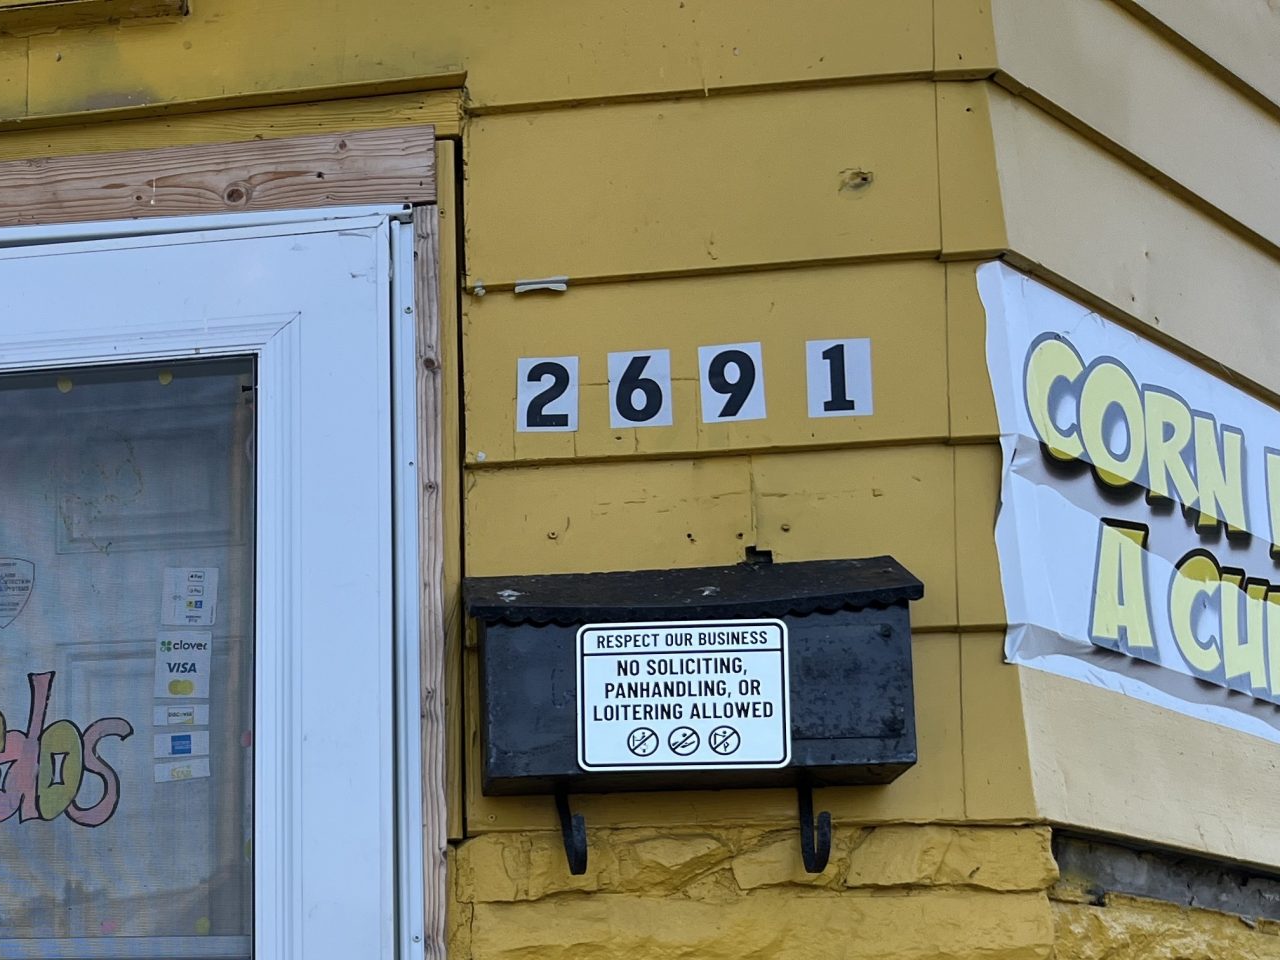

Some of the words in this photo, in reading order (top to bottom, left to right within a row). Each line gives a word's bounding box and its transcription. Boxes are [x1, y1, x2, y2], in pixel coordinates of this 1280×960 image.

[526, 343, 856, 428] 2691
[1023, 331, 1249, 538] CORN
[1089, 518, 1157, 652] A
[173, 639, 208, 650] clover
[596, 633, 660, 649] RESPECT
[665, 632, 693, 647] OUR
[698, 630, 768, 646] BUSINESS
[166, 662, 198, 673] VISA
[616, 659, 640, 677] NO
[646, 657, 748, 676] SOLICITING,
[604, 679, 732, 699] PANHANDLING,
[738, 679, 762, 696] OR
[593, 703, 683, 722] LOITERING
[690, 701, 774, 720] ALLOWED
